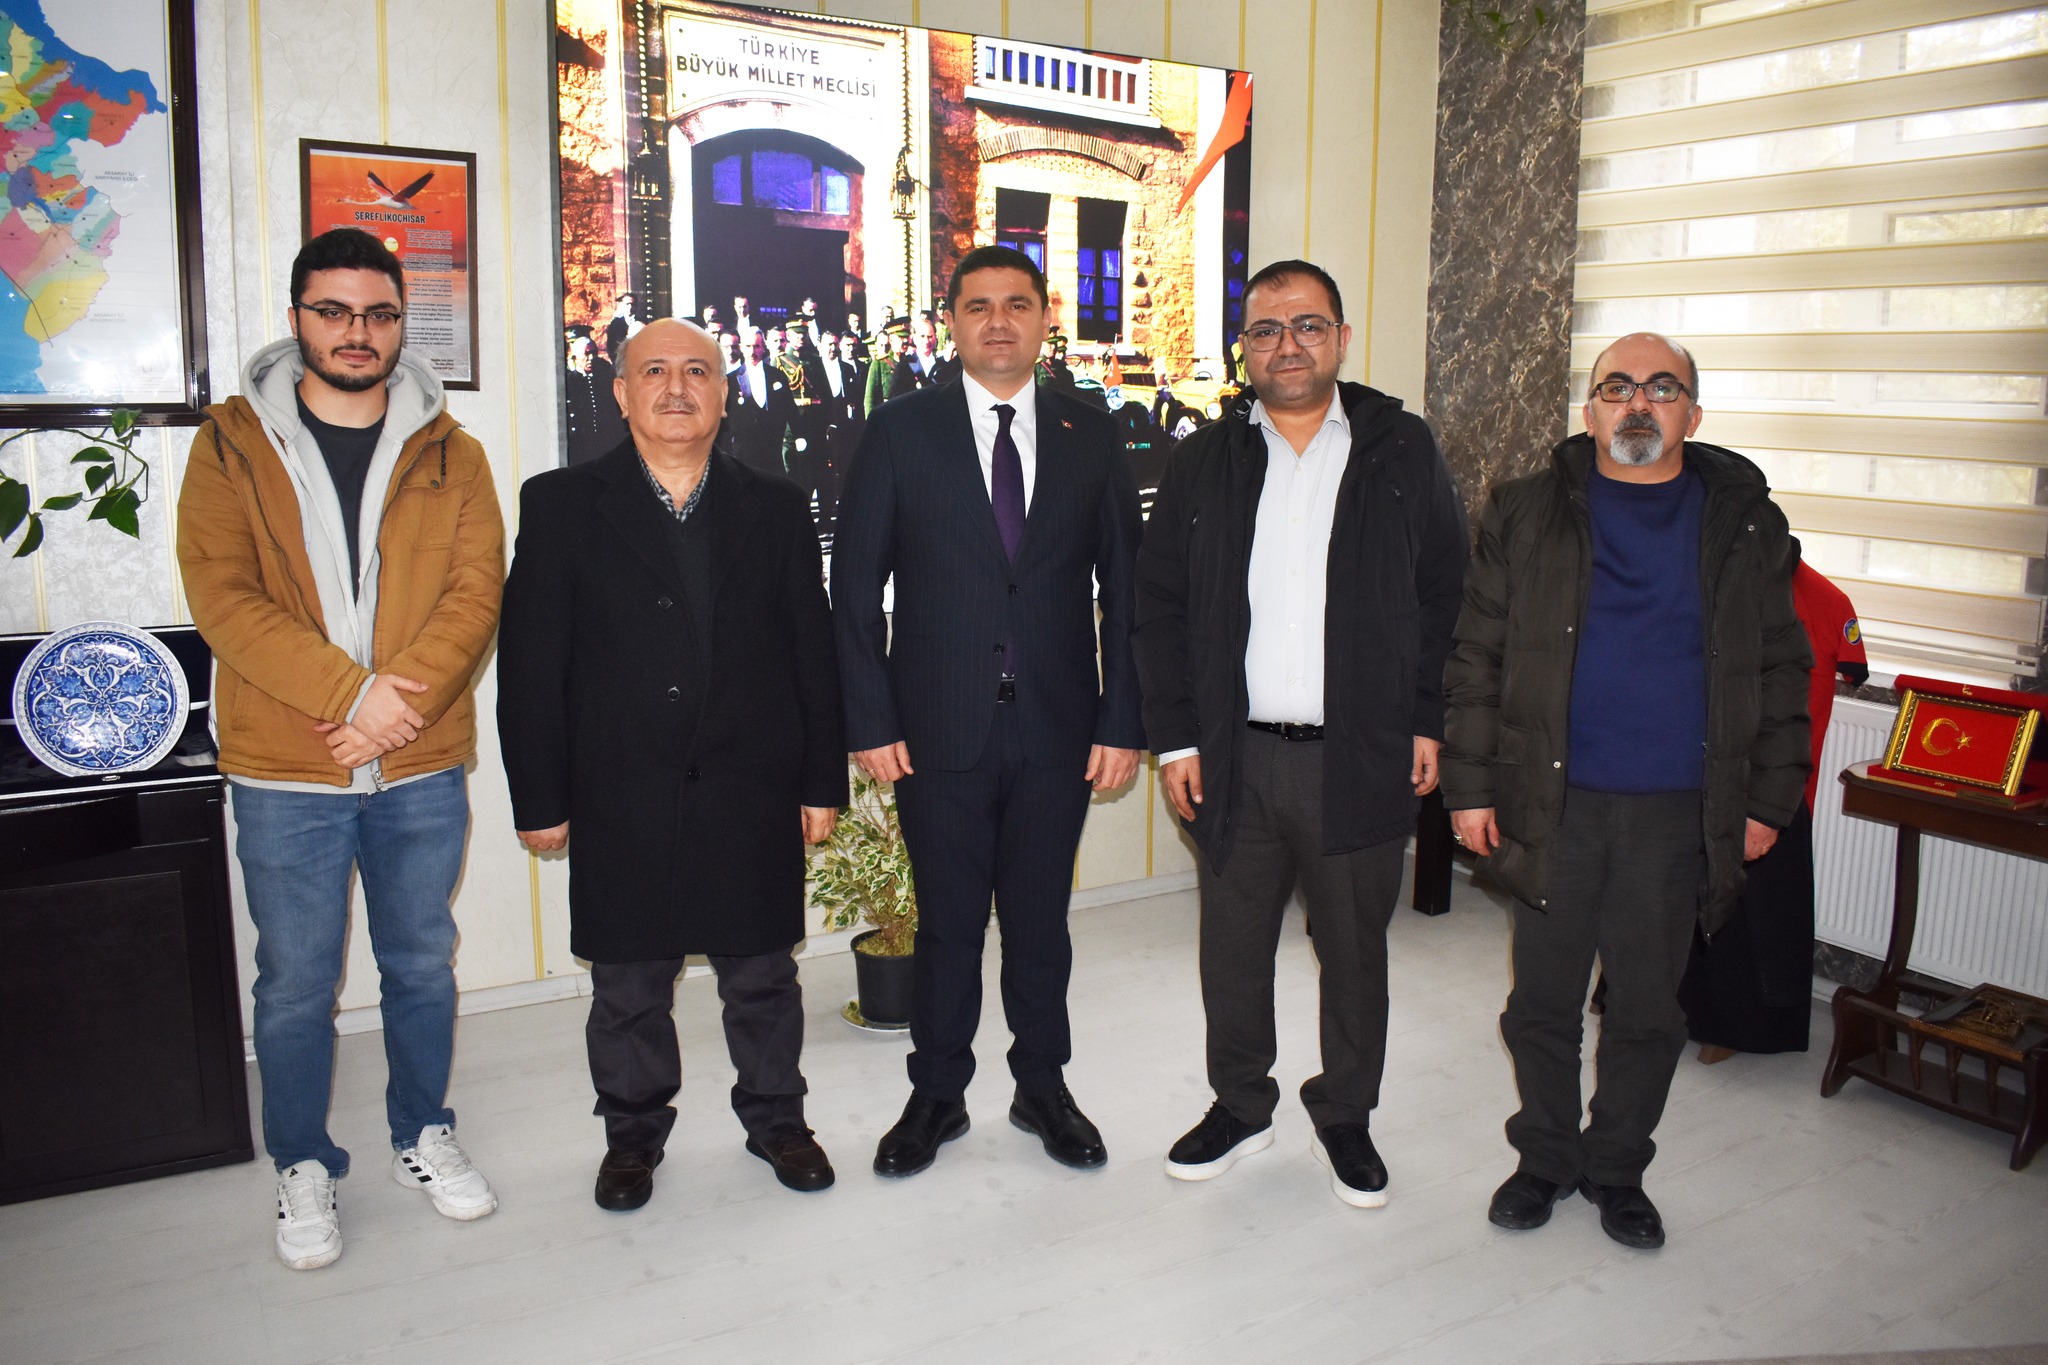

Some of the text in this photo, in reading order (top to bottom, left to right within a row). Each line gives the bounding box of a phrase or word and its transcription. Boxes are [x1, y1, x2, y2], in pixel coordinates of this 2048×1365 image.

[739, 35, 820, 65] TÜRKİYE
[676, 53, 876, 98] BÜYÜK MİLLET MECLİSİ
[354, 211, 426, 224] ŞEREFLİKOÇHİSAR
